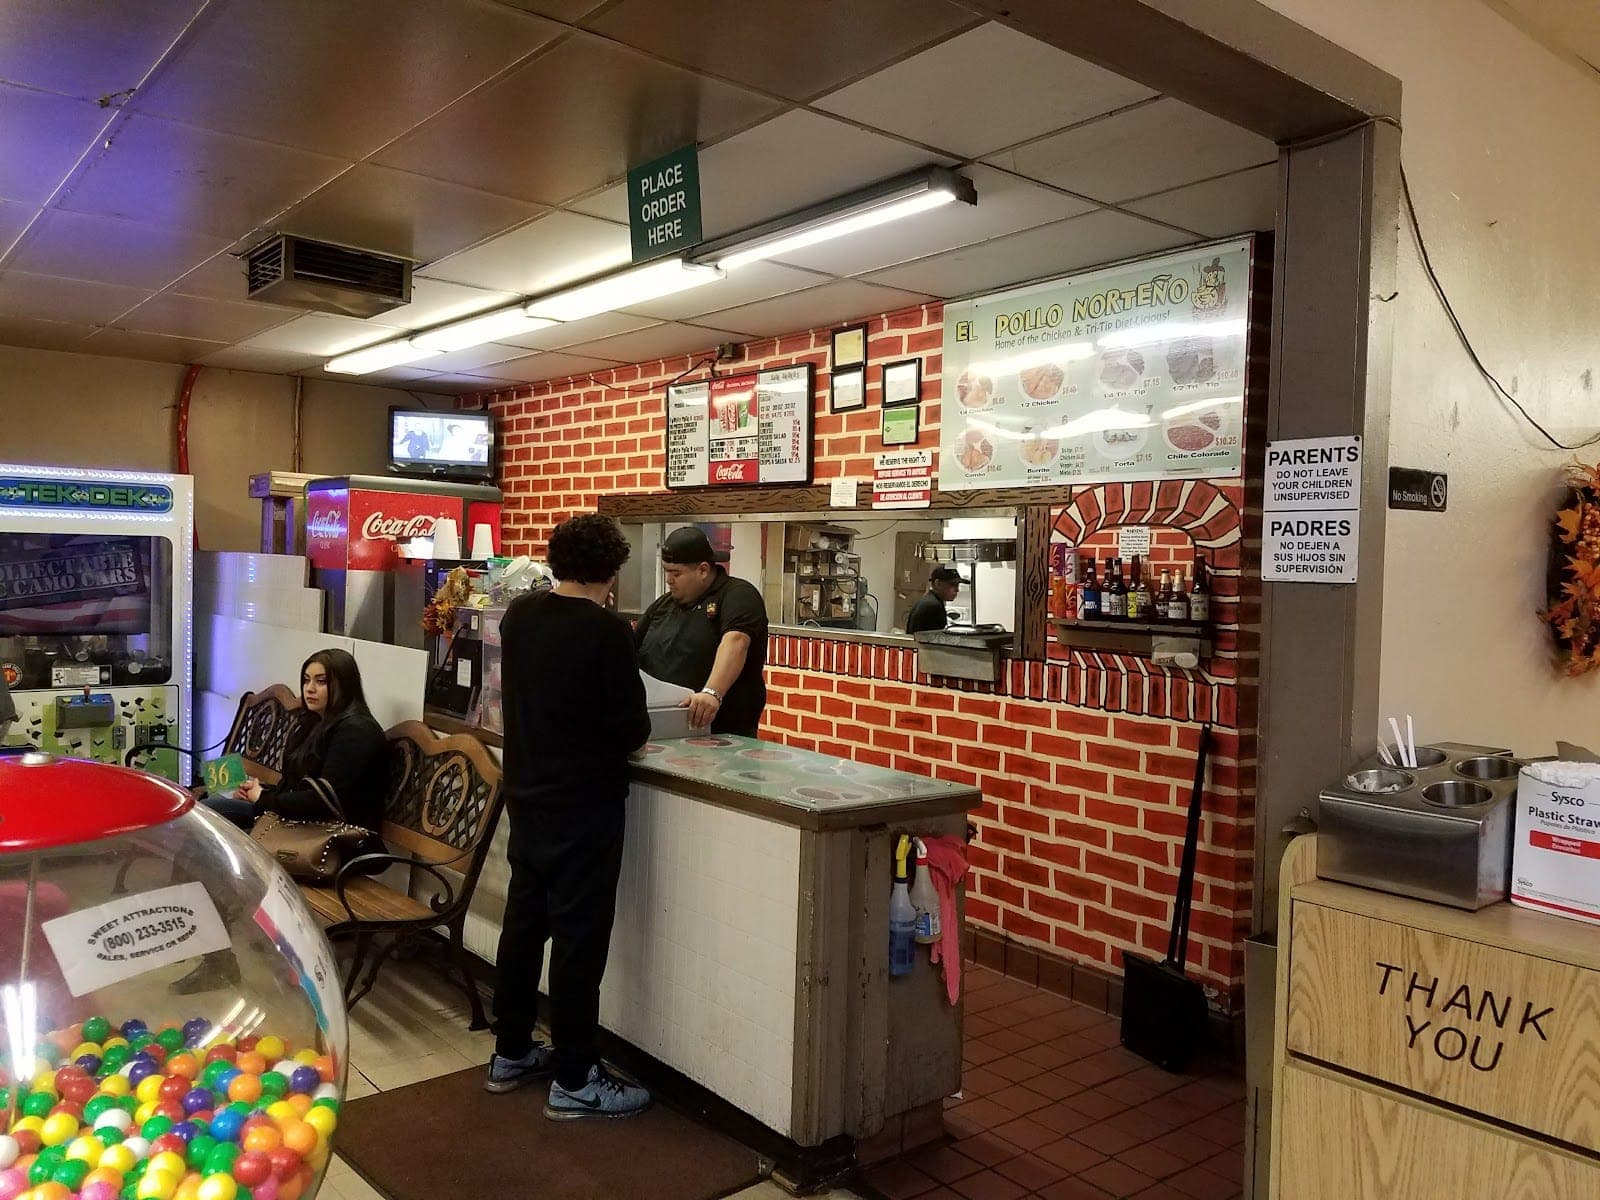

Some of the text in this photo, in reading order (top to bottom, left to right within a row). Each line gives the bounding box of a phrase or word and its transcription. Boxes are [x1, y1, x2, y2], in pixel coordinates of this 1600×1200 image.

[641, 163, 683, 197] PLACE
[642, 190, 686, 222] ORDER
[648, 218, 682, 247] HERE
[955, 274, 1189, 342] EL POLLO NORTEÑO
[995, 340, 1015, 349] Home
[1017, 336, 1026, 346] of
[1028, 334, 1038, 343] the
[1041, 330, 1071, 343] Chicken
[1074, 327, 1082, 335] &
[1085, 321, 1113, 335] Tri-Tip
[1031, 399, 1060, 407] Chicken
[1215, 436, 1237, 446] $10.25
[1190, 450, 1230, 458] Colorado
[1269, 446, 1359, 466] PARENTS
[716, 464, 745, 480] Coca-Cola
[1276, 468, 1349, 479] DO NOT LEAVE
[1272, 479, 1353, 490] YOUR CHILDREN
[18, 483, 147, 507] TEK DEK
[1273, 491, 1350, 501] UNSUPERVISED
[1393, 489, 1428, 505] No Smoking
[1270, 520, 1351, 536] PADRES
[1280, 542, 1340, 550] NO DEJEN A
[1273, 553, 1346, 562] SUS HIJOS SIN
[1275, 563, 1343, 574] SUPERVISIÓN
[13, 573, 76, 595] CAMO
[80, 566, 137, 587] CARS
[1551, 791, 1584, 806] Sysco
[1528, 806, 1565, 822] Plastic
[87, 905, 194, 945] SWEET ATTRACTIONS
[103, 916, 186, 954] (800) 233-3515
[129, 945, 165, 959] SERVICE
[165, 939, 177, 949] OR
[1375, 961, 1554, 1041] THANK
[1406, 1014, 1504, 1072] YOU
